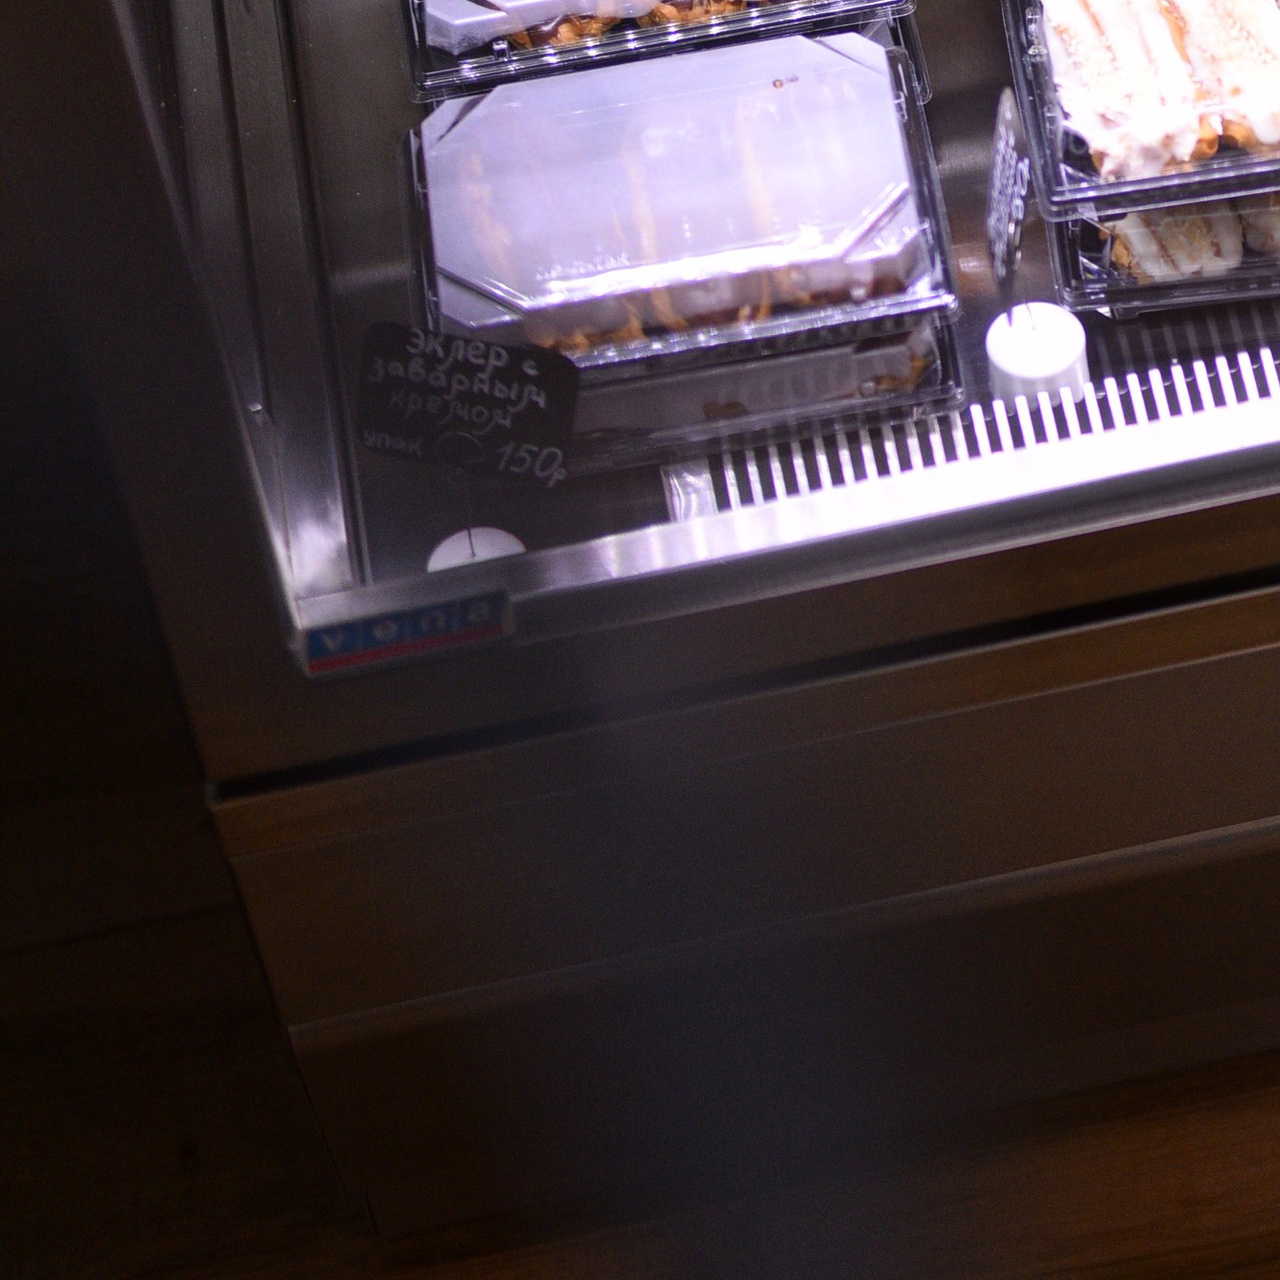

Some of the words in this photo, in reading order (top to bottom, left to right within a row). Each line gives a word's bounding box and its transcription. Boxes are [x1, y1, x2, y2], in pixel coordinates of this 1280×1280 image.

[368, 356, 547, 413] заварным
[521, 359, 539, 376] с
[389, 387, 512, 436] кремом
[496, 441, 568, 489] 150р
